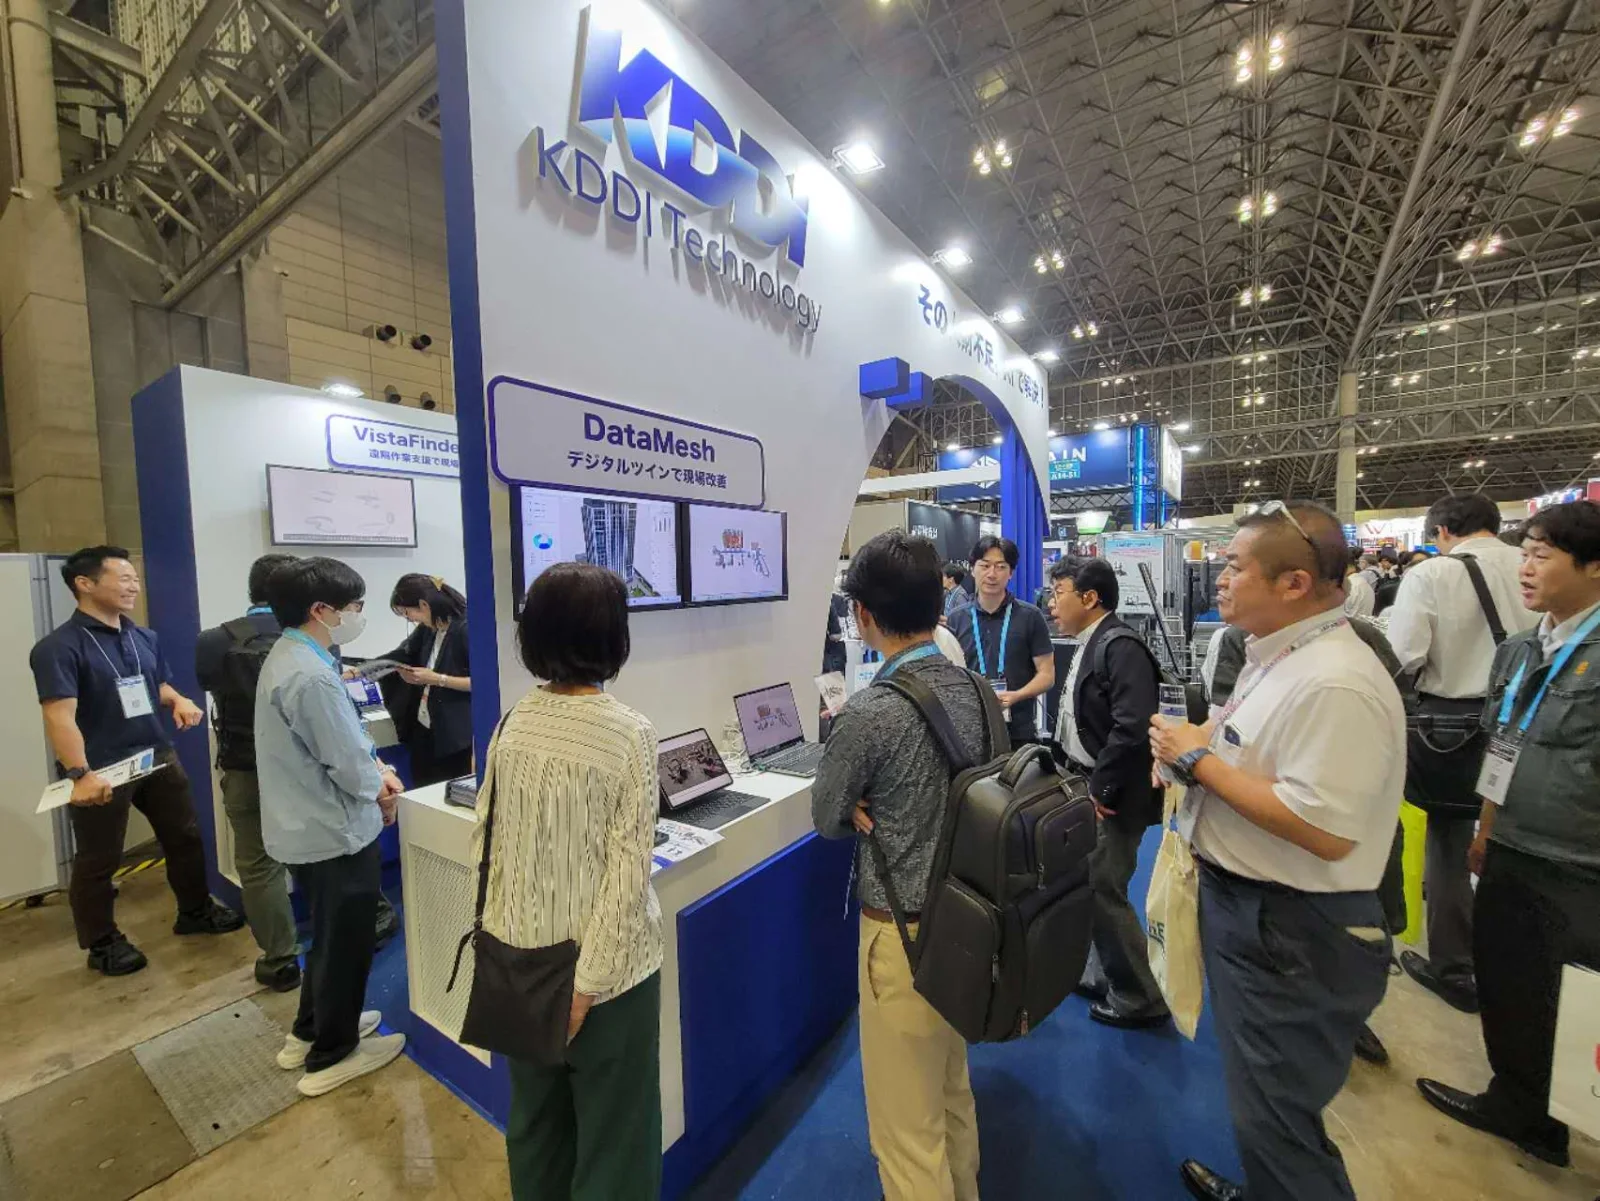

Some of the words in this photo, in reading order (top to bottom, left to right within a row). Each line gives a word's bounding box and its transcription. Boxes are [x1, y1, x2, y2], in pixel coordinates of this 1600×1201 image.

[577, 5, 809, 268] KDDI
[537, 126, 652, 237] KDDI
[664, 202, 821, 333] Technology
[567, 451, 727, 489] デジタルツインで現場改善
[584, 413, 715, 462] DataMesh
